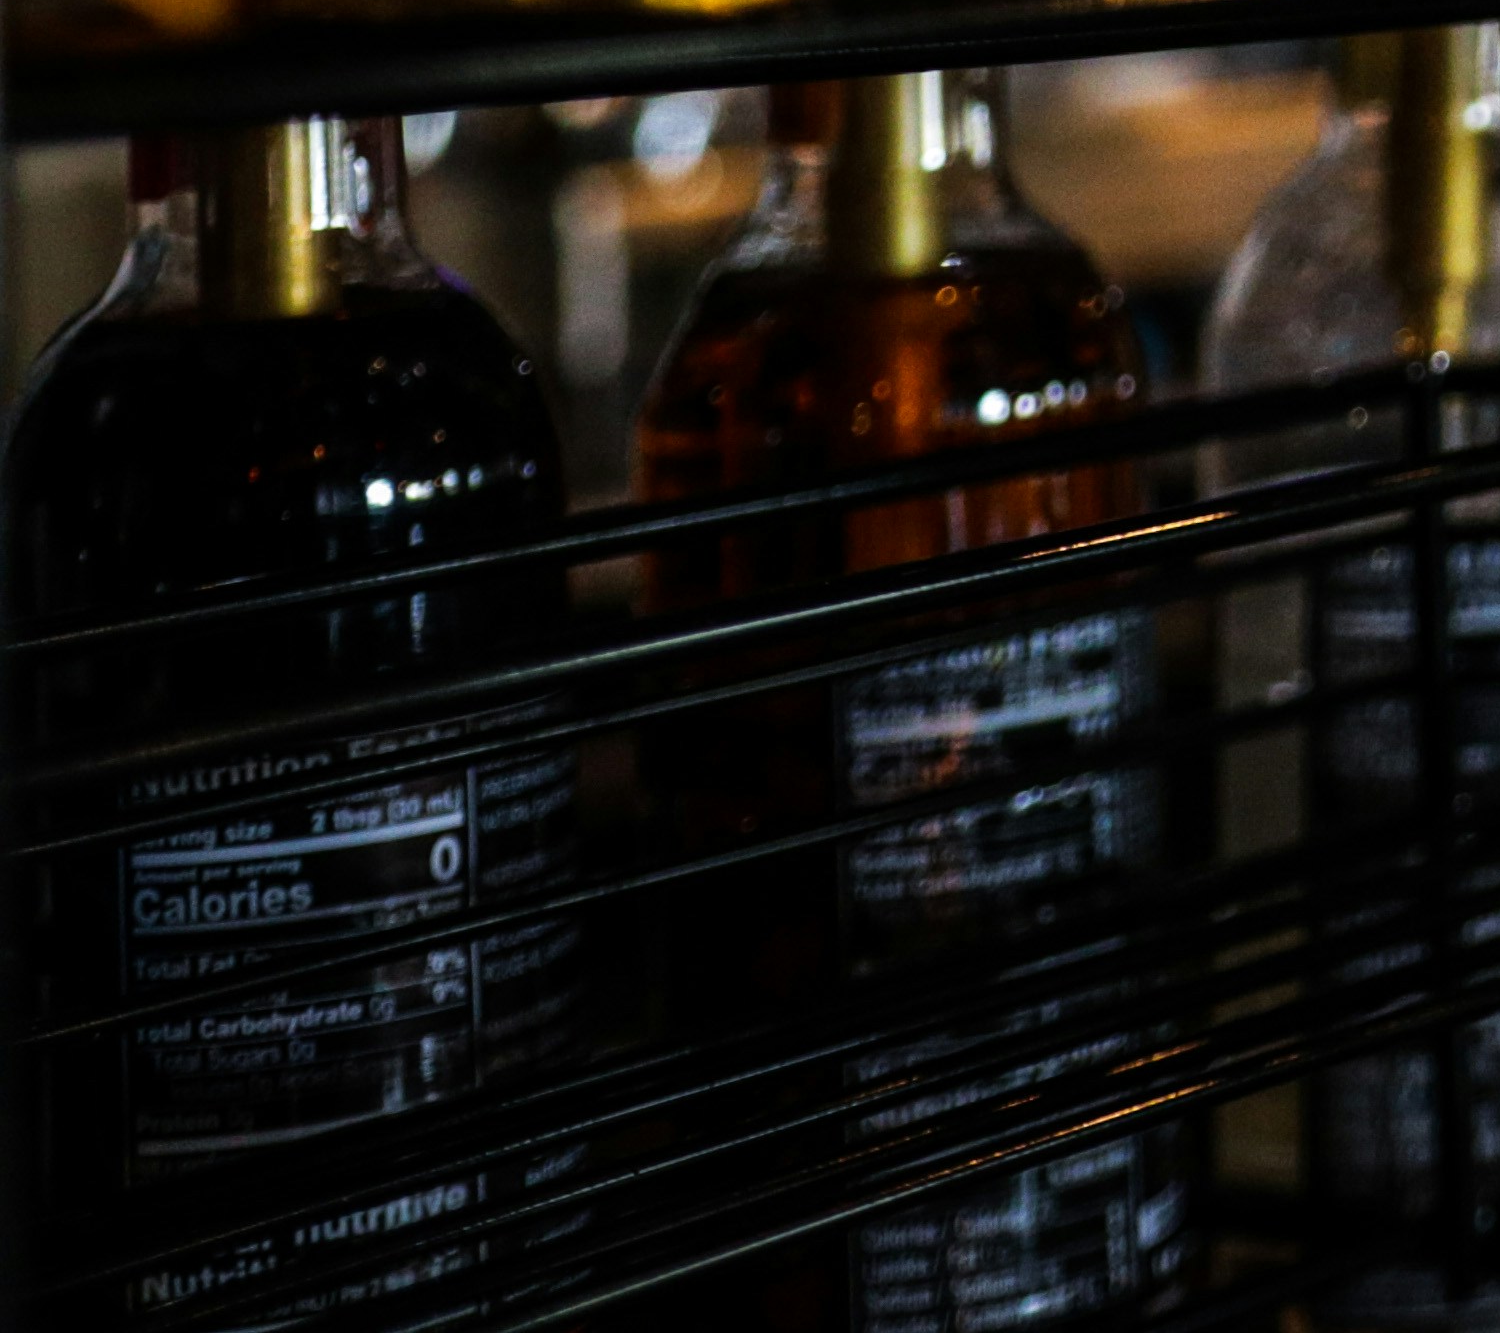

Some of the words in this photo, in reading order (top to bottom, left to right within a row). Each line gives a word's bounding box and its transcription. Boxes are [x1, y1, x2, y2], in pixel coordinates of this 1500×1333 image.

[310, 807, 328, 835] 2
[131, 876, 316, 927] Calories
[428, 834, 463, 884] 0
[235, 857, 303, 883] serving
[136, 1012, 194, 1046] Total
[198, 998, 365, 1041] Carbohydrate
